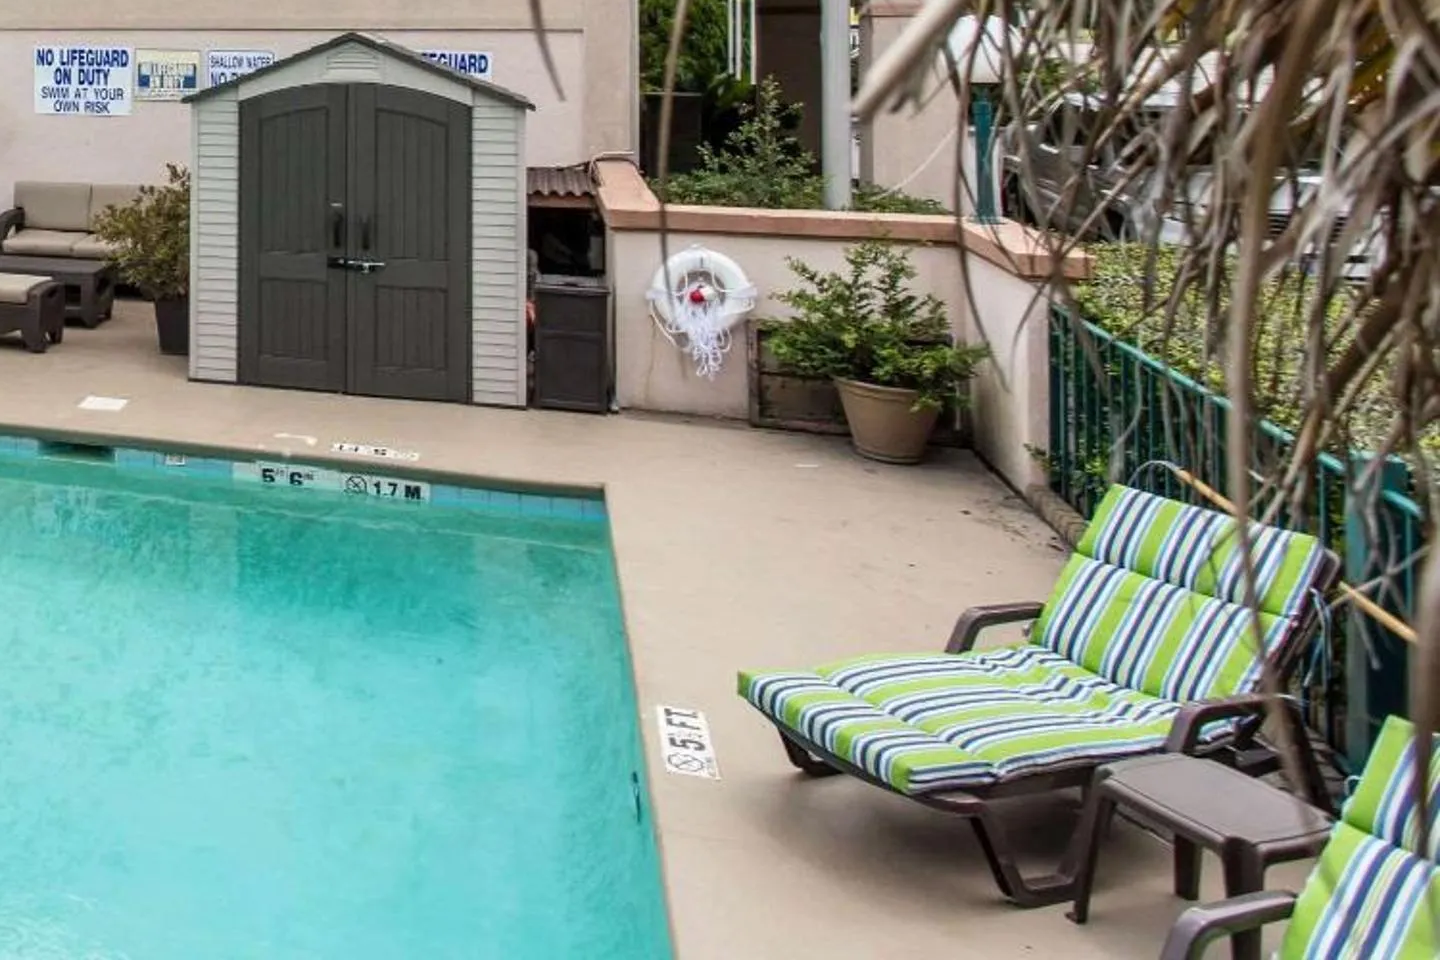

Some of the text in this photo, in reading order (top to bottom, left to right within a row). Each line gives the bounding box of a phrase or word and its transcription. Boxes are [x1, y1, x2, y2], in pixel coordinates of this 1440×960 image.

[37, 48, 129, 68] NO LIFEGUARD
[210, 55, 244, 69] SHALLOW
[422, 53, 489, 74] GUARD
[54, 68, 110, 86] ON DUTY
[41, 86, 124, 101] SWIM AT YOUR
[53, 100, 110, 114] OWN RISK
[405, 484, 421, 500] M
[667, 736, 706, 752] 5
